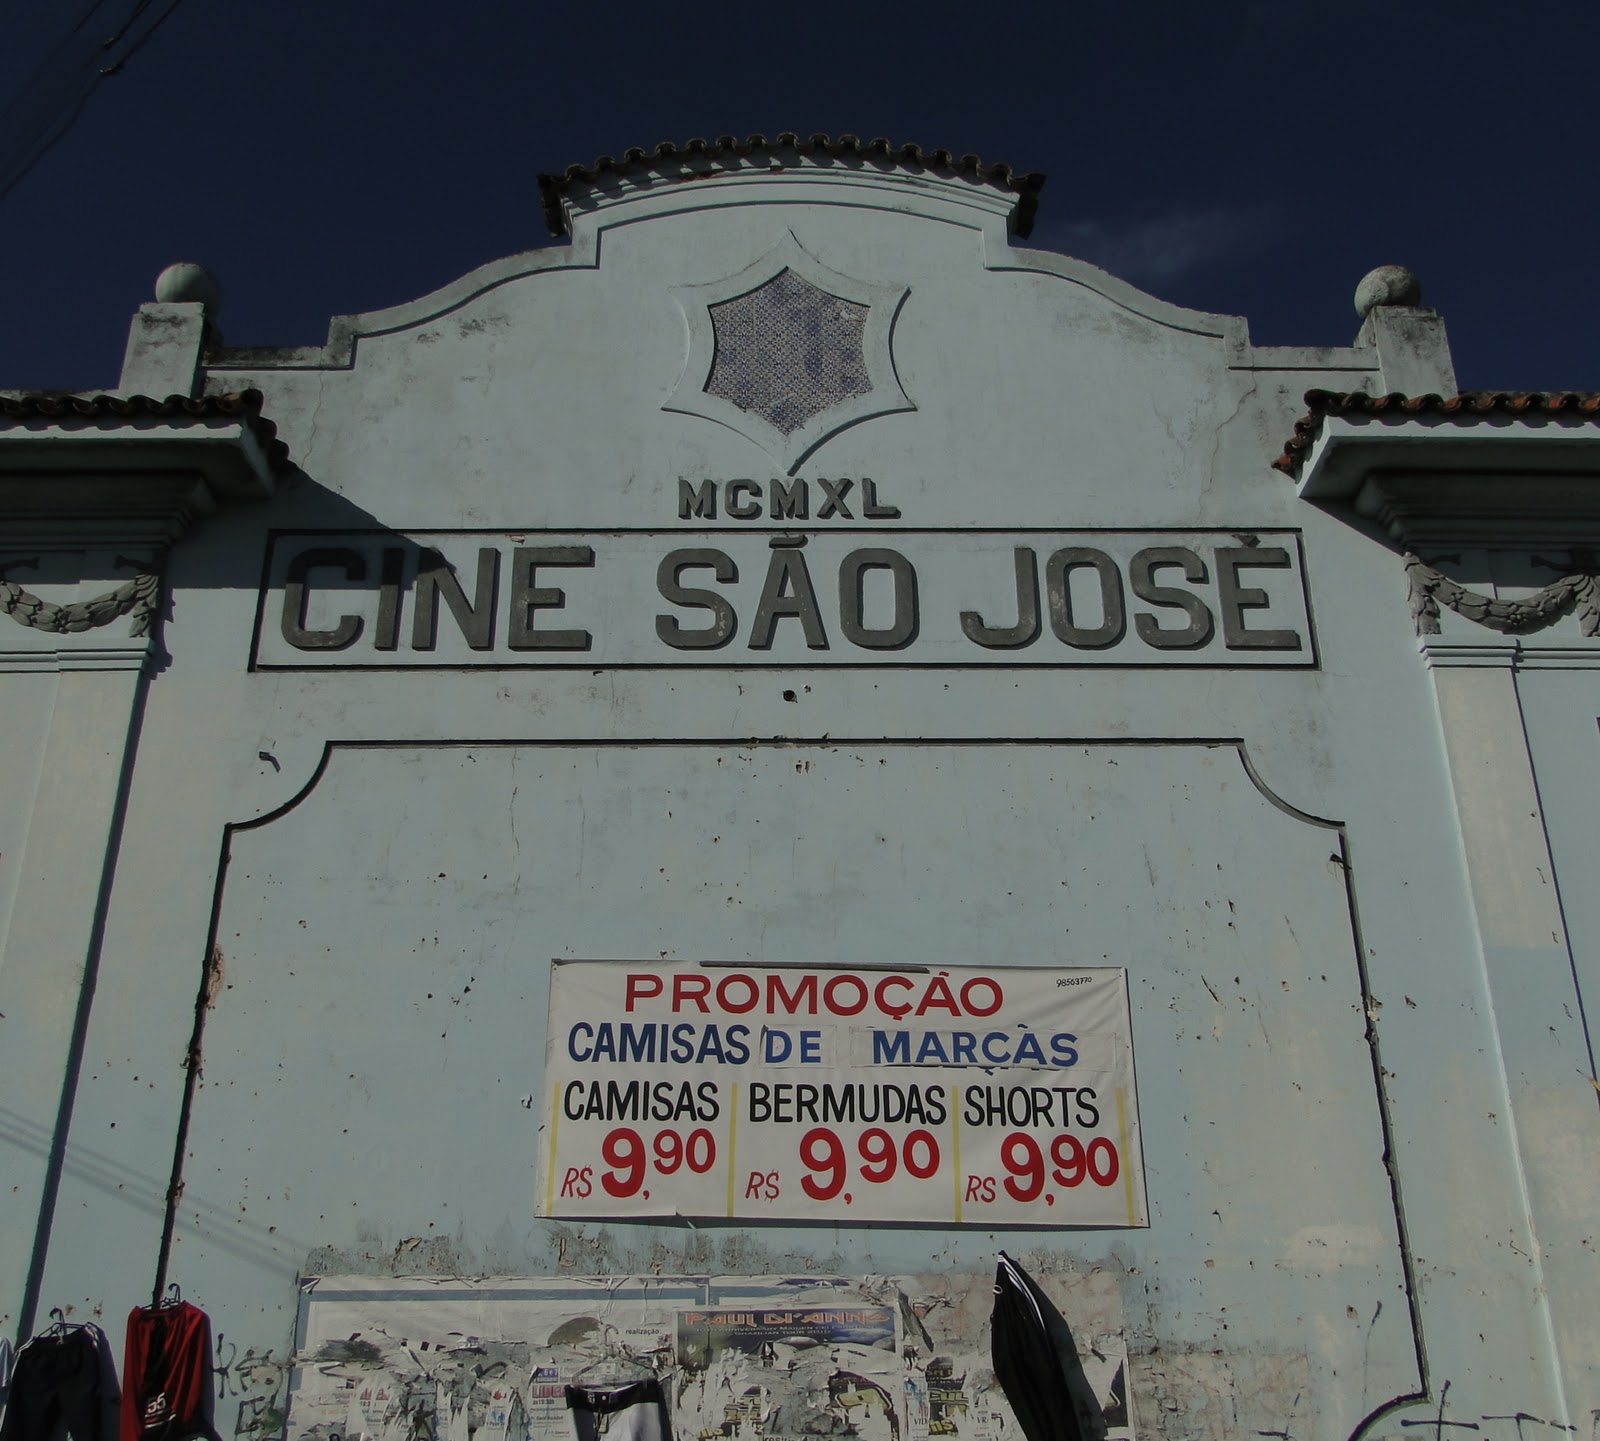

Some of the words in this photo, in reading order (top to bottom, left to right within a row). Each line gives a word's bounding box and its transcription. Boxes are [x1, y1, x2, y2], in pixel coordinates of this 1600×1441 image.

[679, 477, 901, 519] MCMXL
[279, 545, 594, 652] CINE
[656, 534, 920, 651] SÃO
[625, 972, 1004, 1020] PROMOÇÃO
[568, 1022, 750, 1064] CAMISAS
[764, 1030, 822, 1064] DE
[564, 1080, 720, 1122] CAMISAS
[749, 1083, 946, 1125] BERMUDAS
[964, 1085, 1100, 1128] SHORTS
[560, 1163, 593, 1199] R$
[601, 1127, 716, 1200] 9,90
[745, 1169, 780, 1203] R$
[799, 1127, 940, 1204] 9,90
[1001, 1132, 1119, 1206] 9,90
[685, 1312, 757, 1327] PAUL
